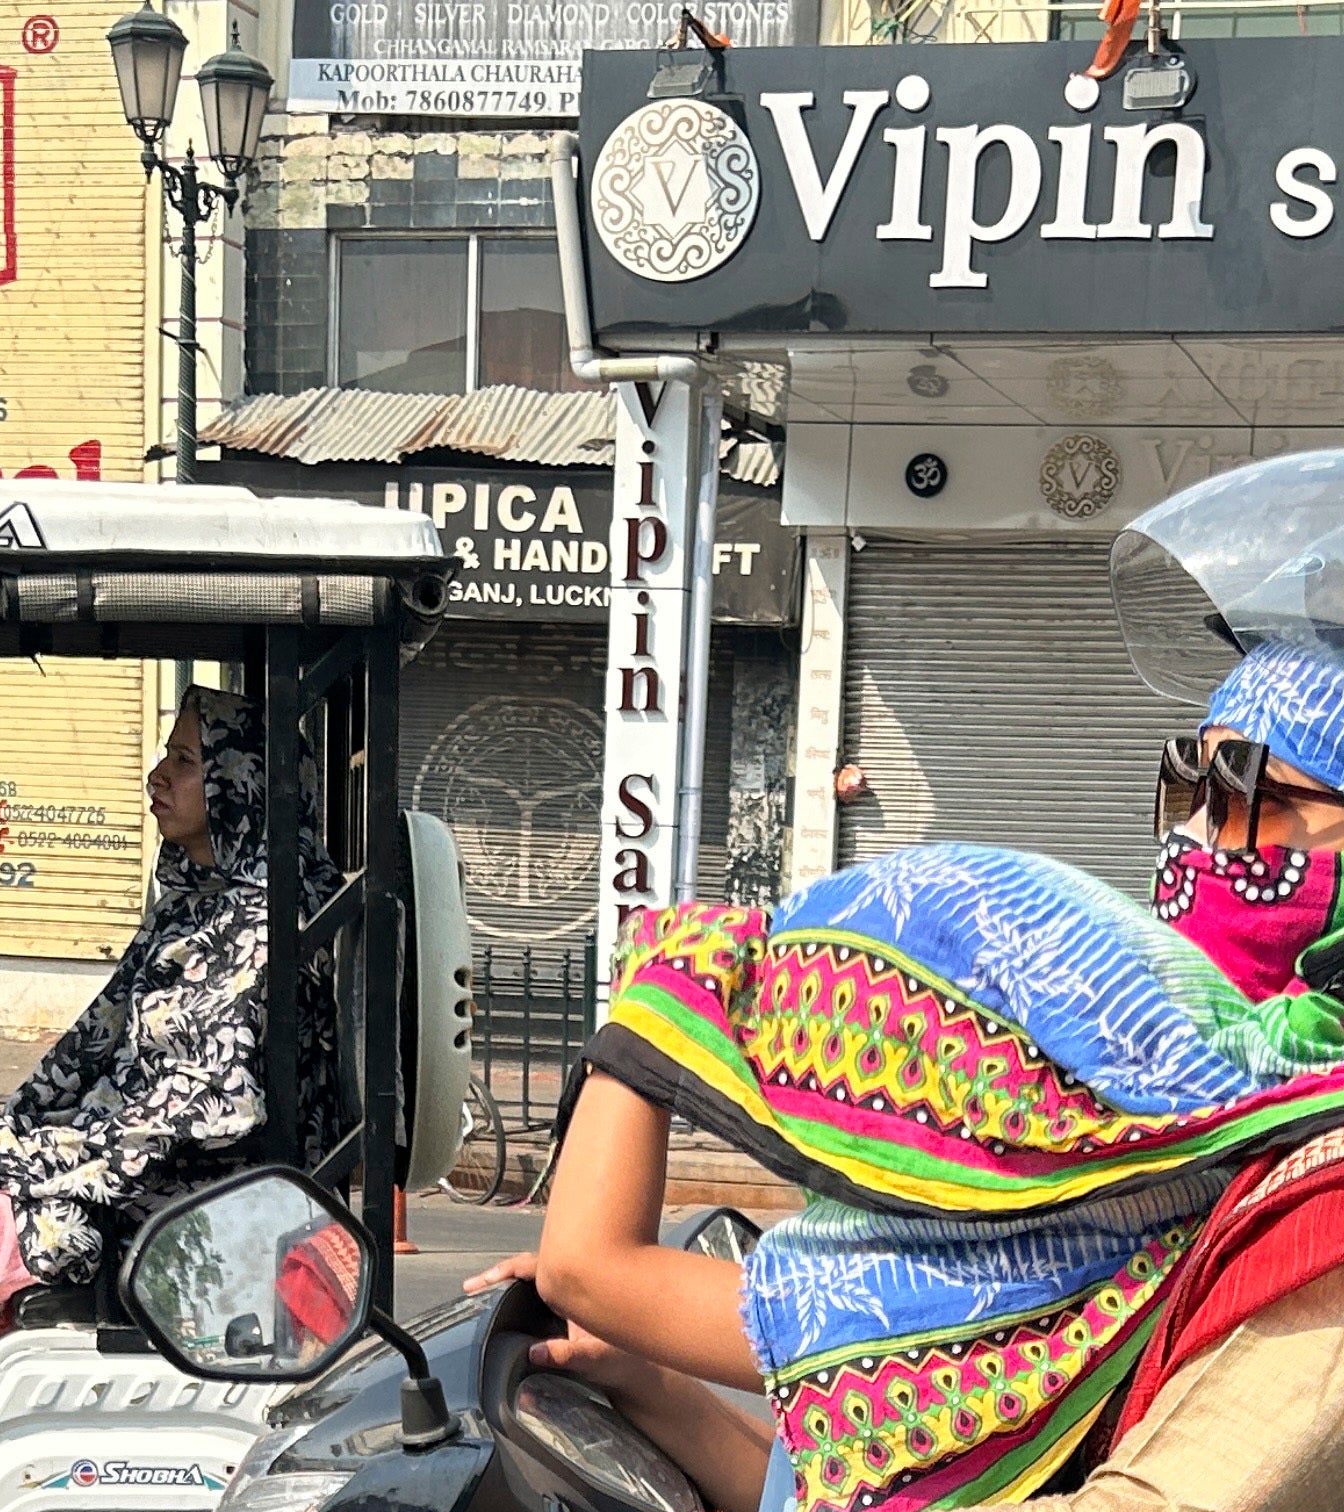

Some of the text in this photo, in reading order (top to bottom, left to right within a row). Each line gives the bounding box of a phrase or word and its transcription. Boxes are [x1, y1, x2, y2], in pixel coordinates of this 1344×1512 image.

[330, 7, 388, 26] GOLD
[414, 5, 485, 26] SILVER
[507, 3, 610, 27] DIAMOND
[705, 2, 790, 24] STONES
[317, 63, 469, 83] KAPOORTHALA
[335, 89, 397, 111] Mob:
[760, 75, 1214, 288] Vipin
[99, 1460, 205, 1486] SHOBHA
